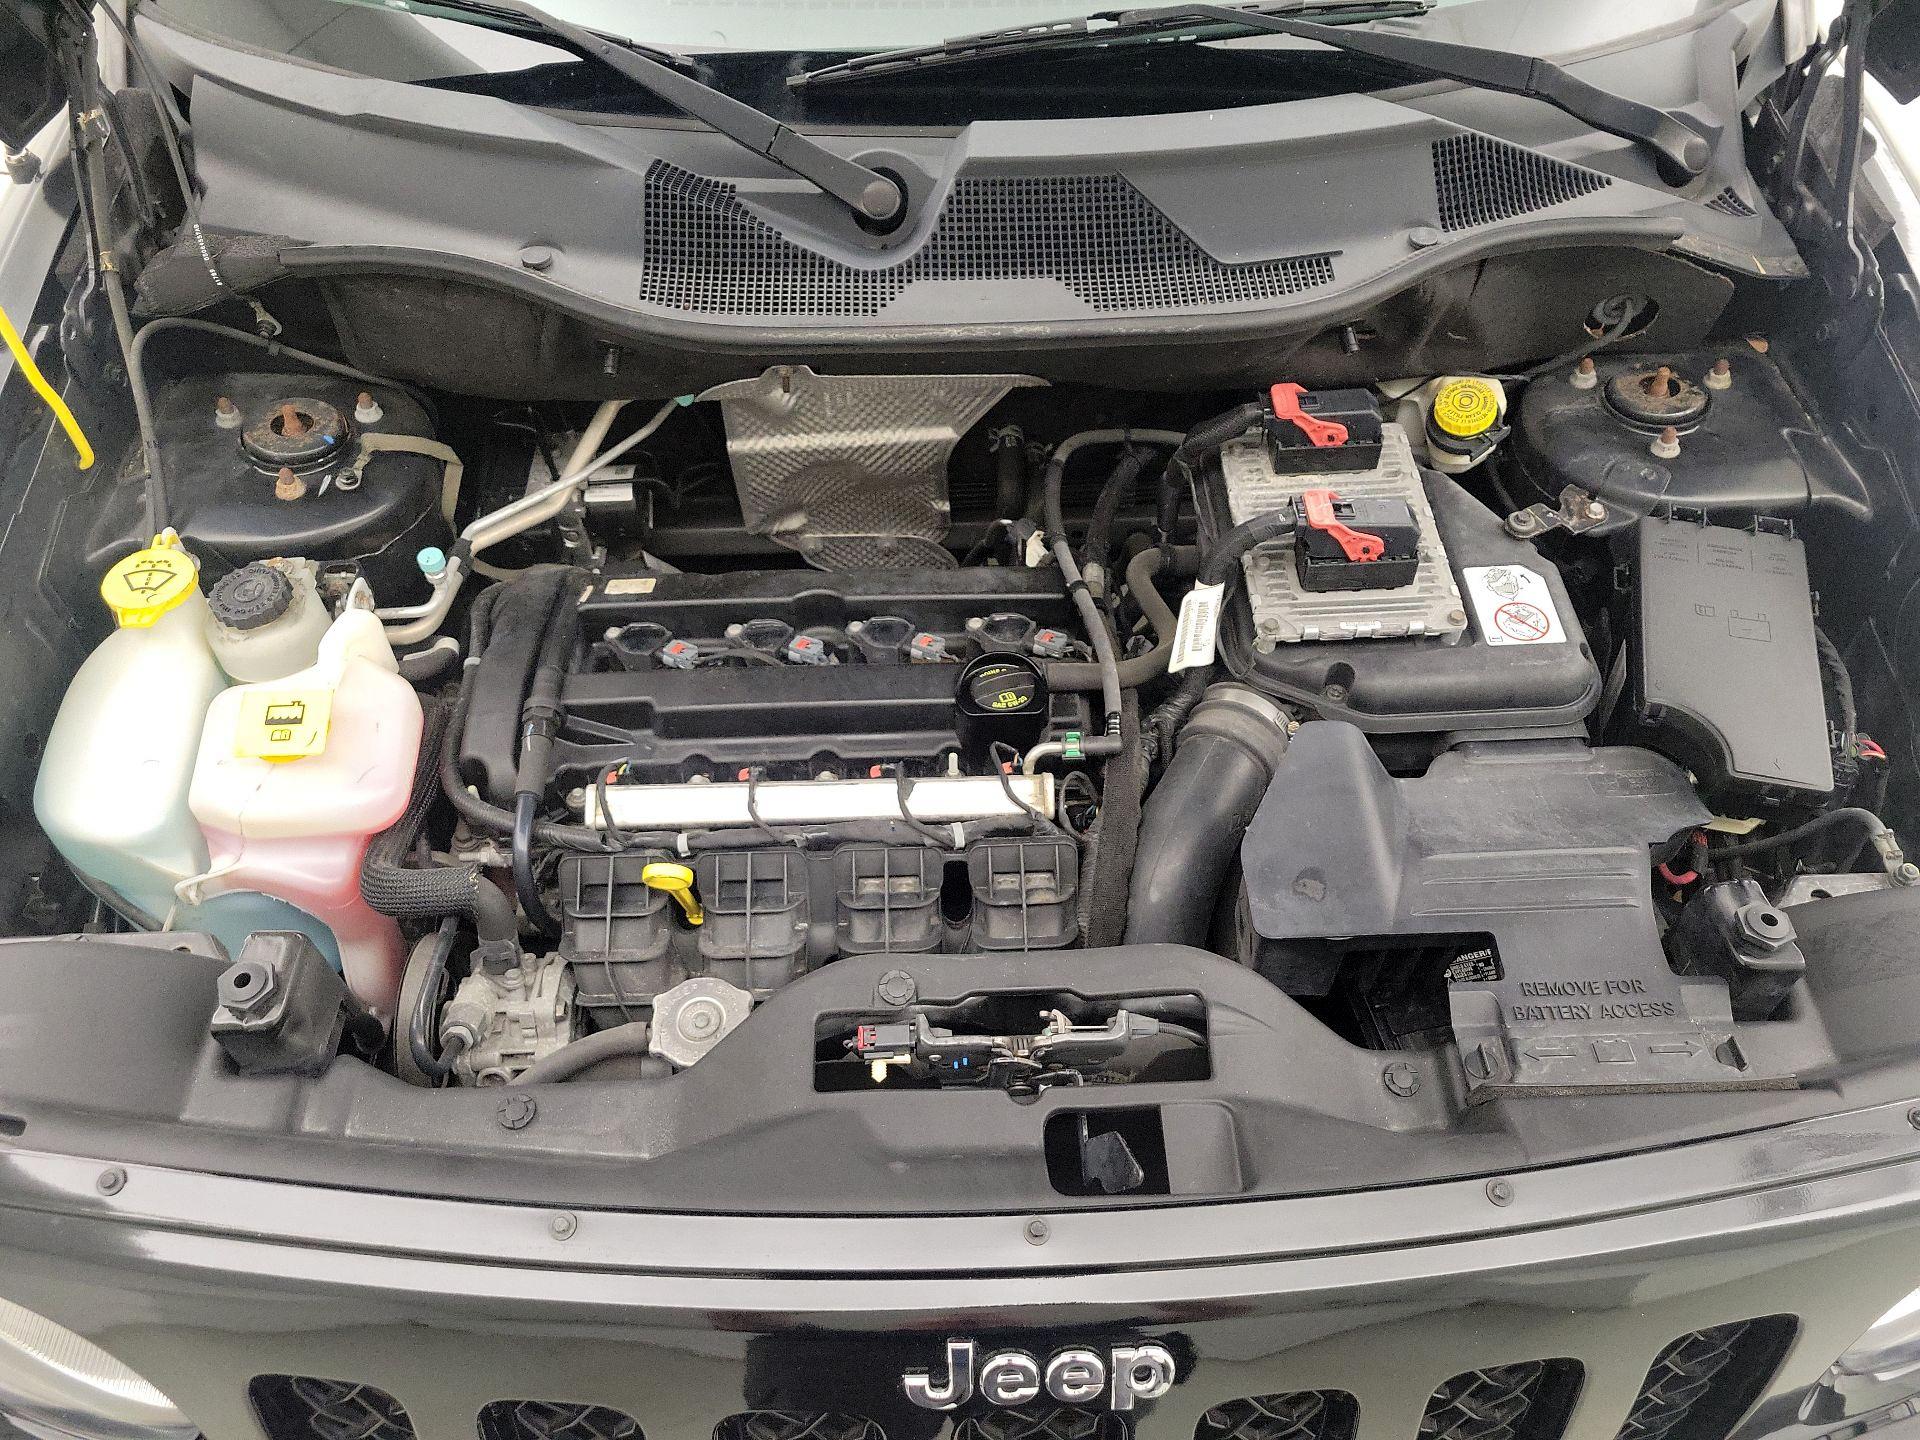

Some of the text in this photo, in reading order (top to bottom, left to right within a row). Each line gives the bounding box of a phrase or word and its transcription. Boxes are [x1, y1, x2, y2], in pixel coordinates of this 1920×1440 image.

[991, 701, 1007, 709] SAE
[1520, 978, 1647, 997] REMOVE FOR
[1512, 1001, 1677, 1021] BATTERY ACCESS
[903, 1337, 1176, 1410] Jeep
